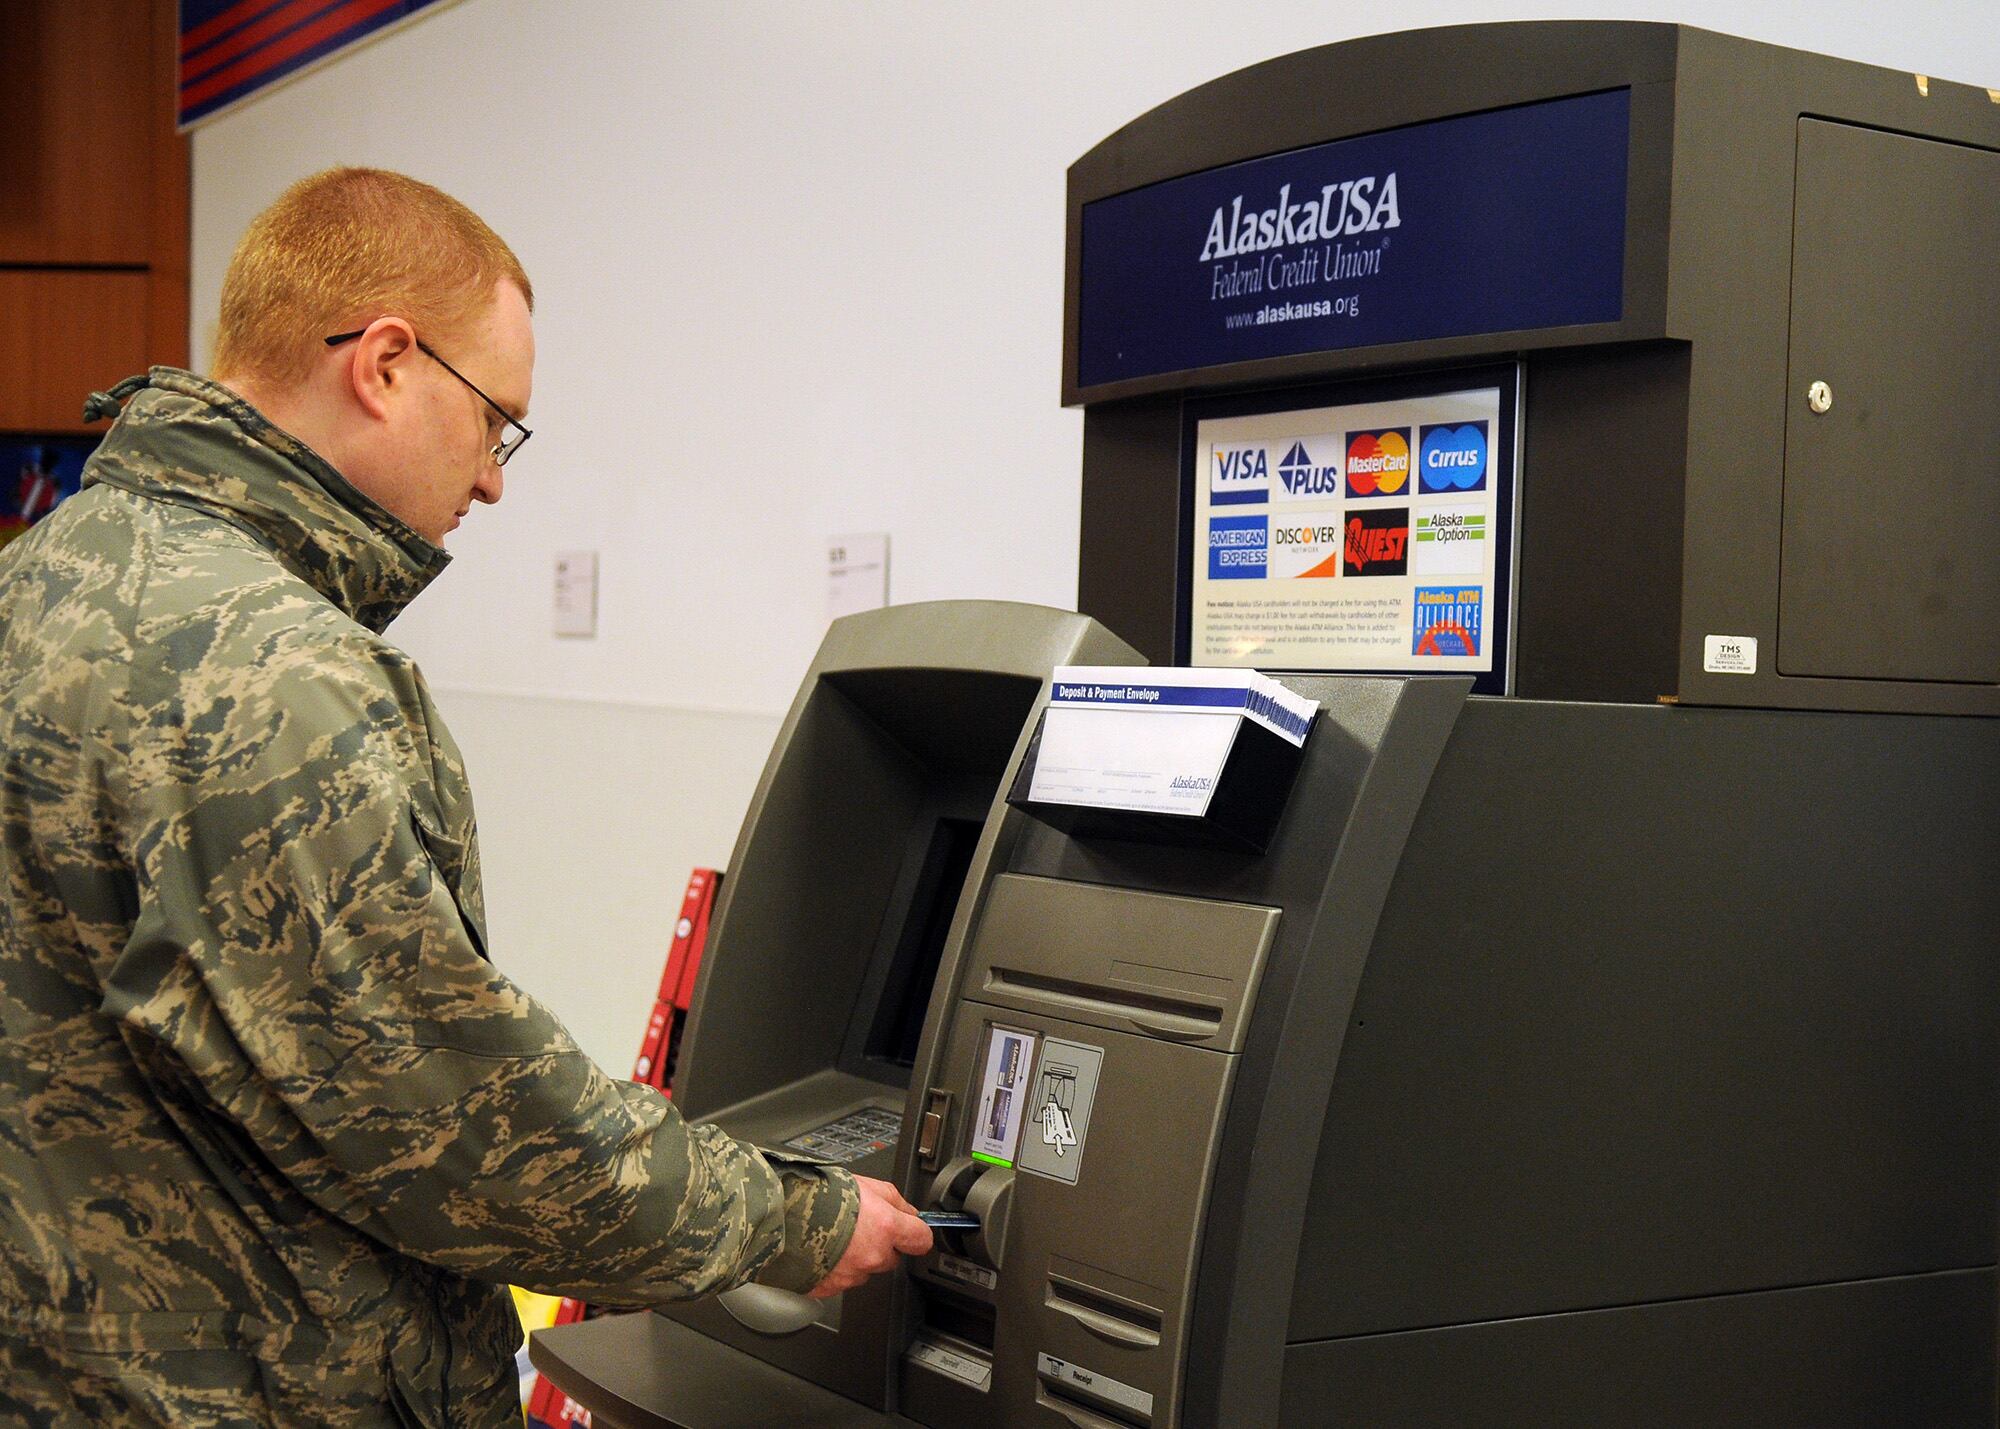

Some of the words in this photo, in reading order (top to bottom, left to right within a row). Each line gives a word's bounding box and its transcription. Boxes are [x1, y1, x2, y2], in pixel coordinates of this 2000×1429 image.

[1199, 172, 1402, 262] AlaskaUSA
[1211, 256, 1265, 301] Federal
[1268, 247, 1320, 290] Credit
[1226, 294, 1360, 329] www.alaskausa.org
[1215, 448, 1268, 480] VISA
[1347, 453, 1409, 474] MasterCard
[1428, 449, 1478, 468] Cirrus
[1293, 466, 1338, 495] PLUS
[1430, 513, 1464, 527] Alaska
[1210, 529, 1266, 547] AMERICAN
[1276, 527, 1336, 544] DISCOVER
[1437, 528, 1471, 544] Option
[1344, 518, 1409, 574] QUEST
[1220, 549, 1268, 566] EXPRESS
[1418, 591, 1455, 604] Alaska
[1456, 590, 1480, 604] ATM
[1417, 604, 1480, 629] ALLIANCE
[1720, 644, 1741, 653] TMS
[1059, 685, 1087, 700] Deposit
[1087, 687, 1094, 698] &
[1094, 686, 1126, 701] Payment
[1126, 687, 1160, 703] Envelope
[1169, 775, 1212, 790] AlaskaUSA
[1072, 1370, 1093, 1387] Receipt
